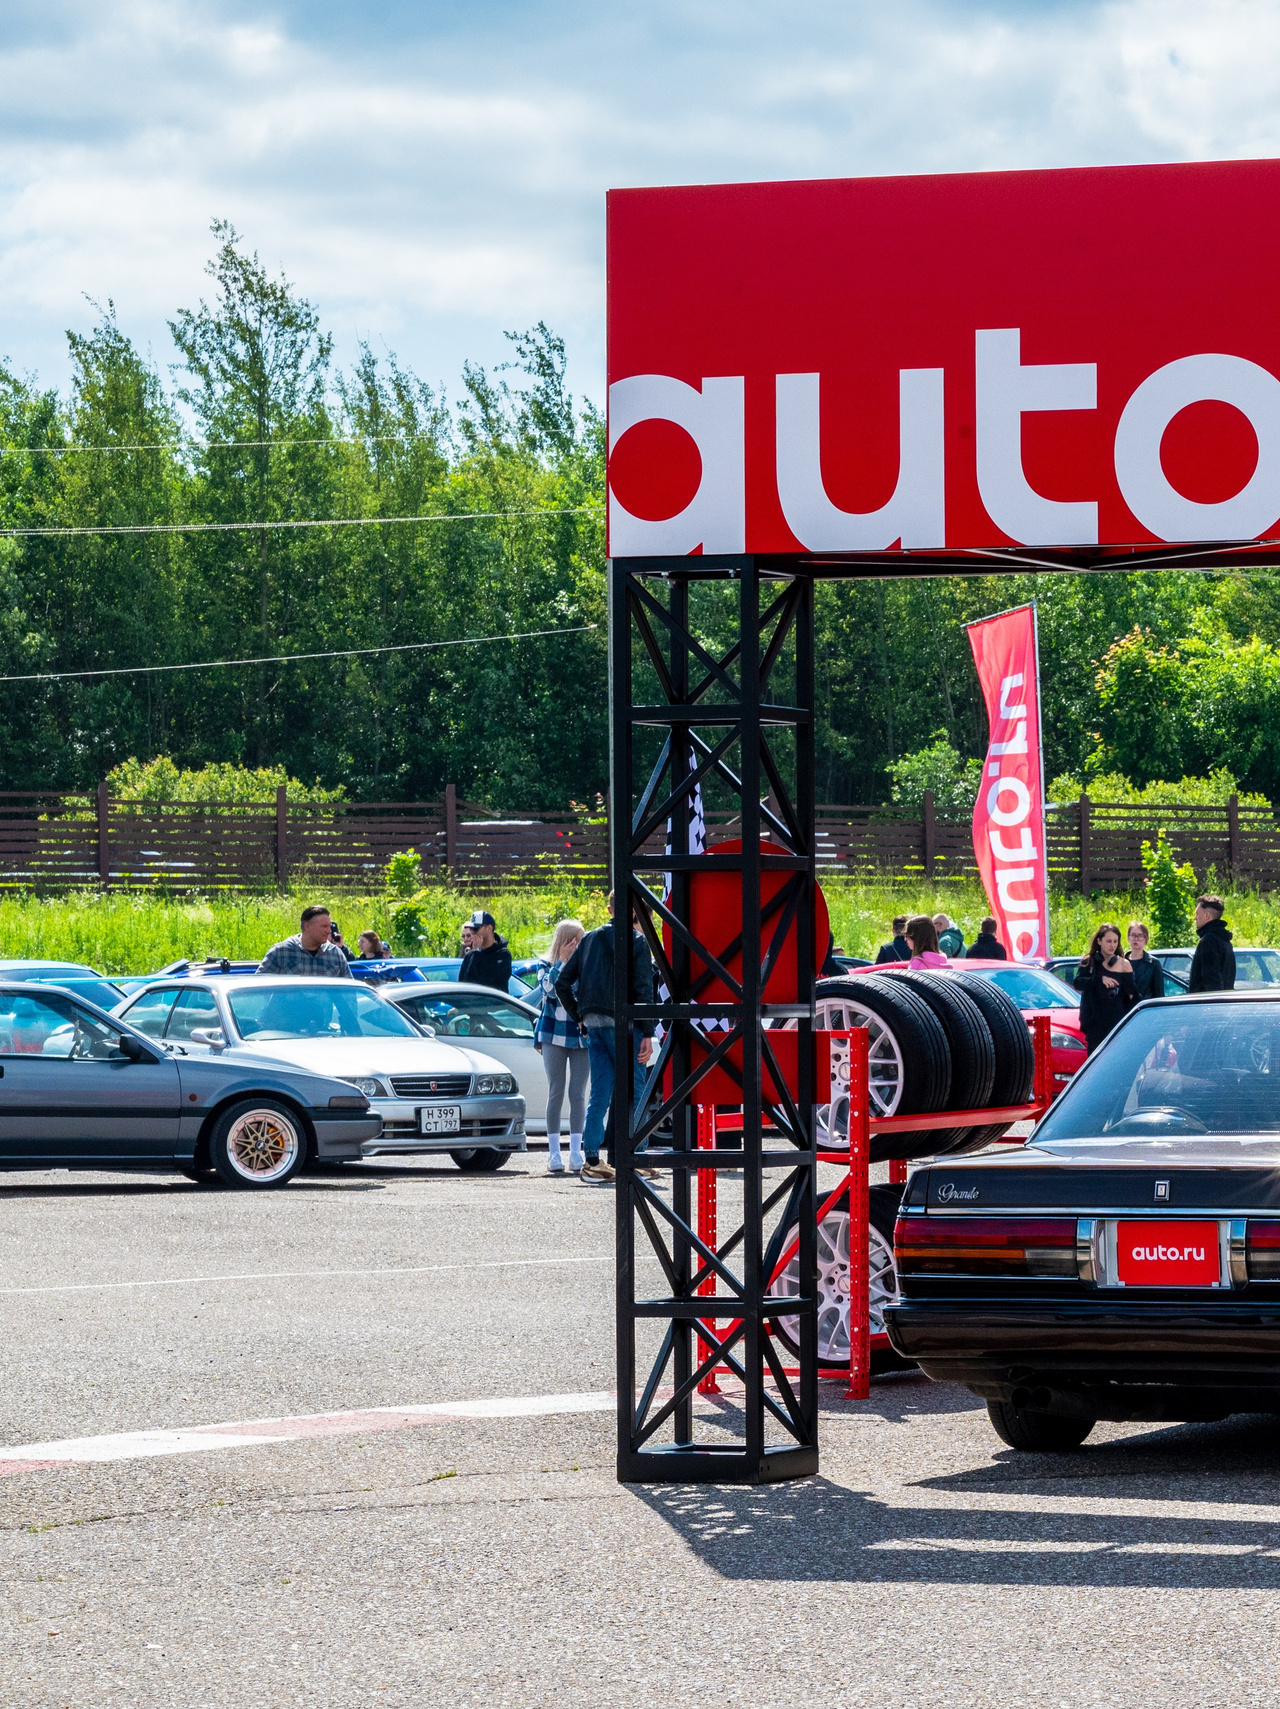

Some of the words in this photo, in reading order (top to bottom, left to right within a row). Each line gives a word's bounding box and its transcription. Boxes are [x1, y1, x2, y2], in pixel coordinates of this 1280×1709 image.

[437, 1108, 454, 1119] 399
[444, 1120, 457, 1128] 797
[938, 1183, 979, 1203] Grande
[1132, 1245, 1205, 1260] auto.ru
